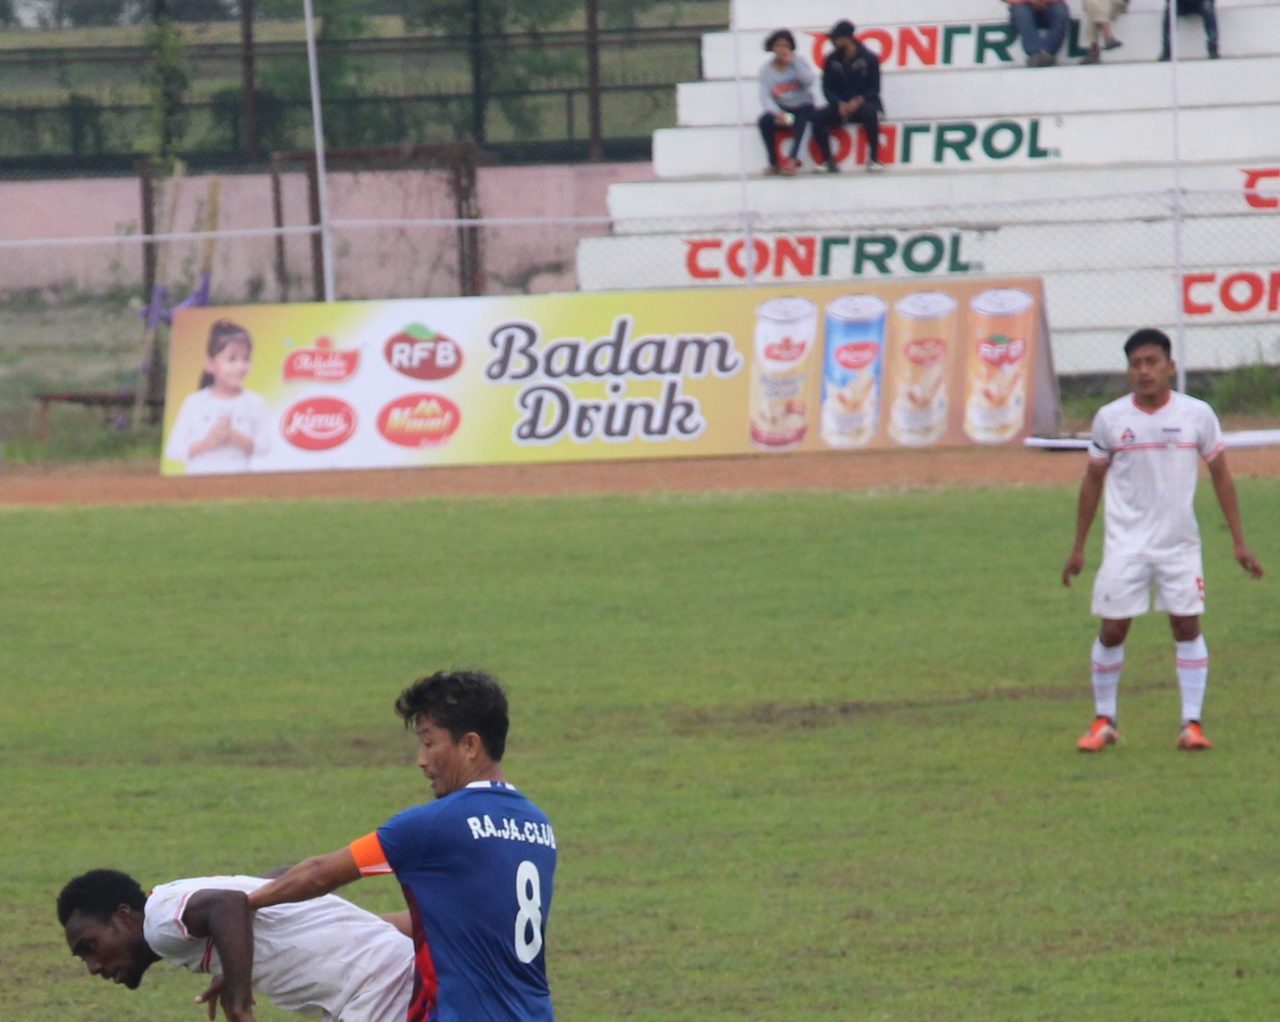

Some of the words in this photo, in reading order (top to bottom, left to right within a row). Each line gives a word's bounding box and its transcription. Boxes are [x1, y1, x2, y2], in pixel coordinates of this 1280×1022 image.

[803, 19, 1090, 68] CONTRL
[680, 235, 970, 279] CONTROL
[391, 342, 457, 368] RFB
[487, 319, 739, 380] Badam
[516, 382, 700, 440] Drink
[515, 860, 543, 964] 8
